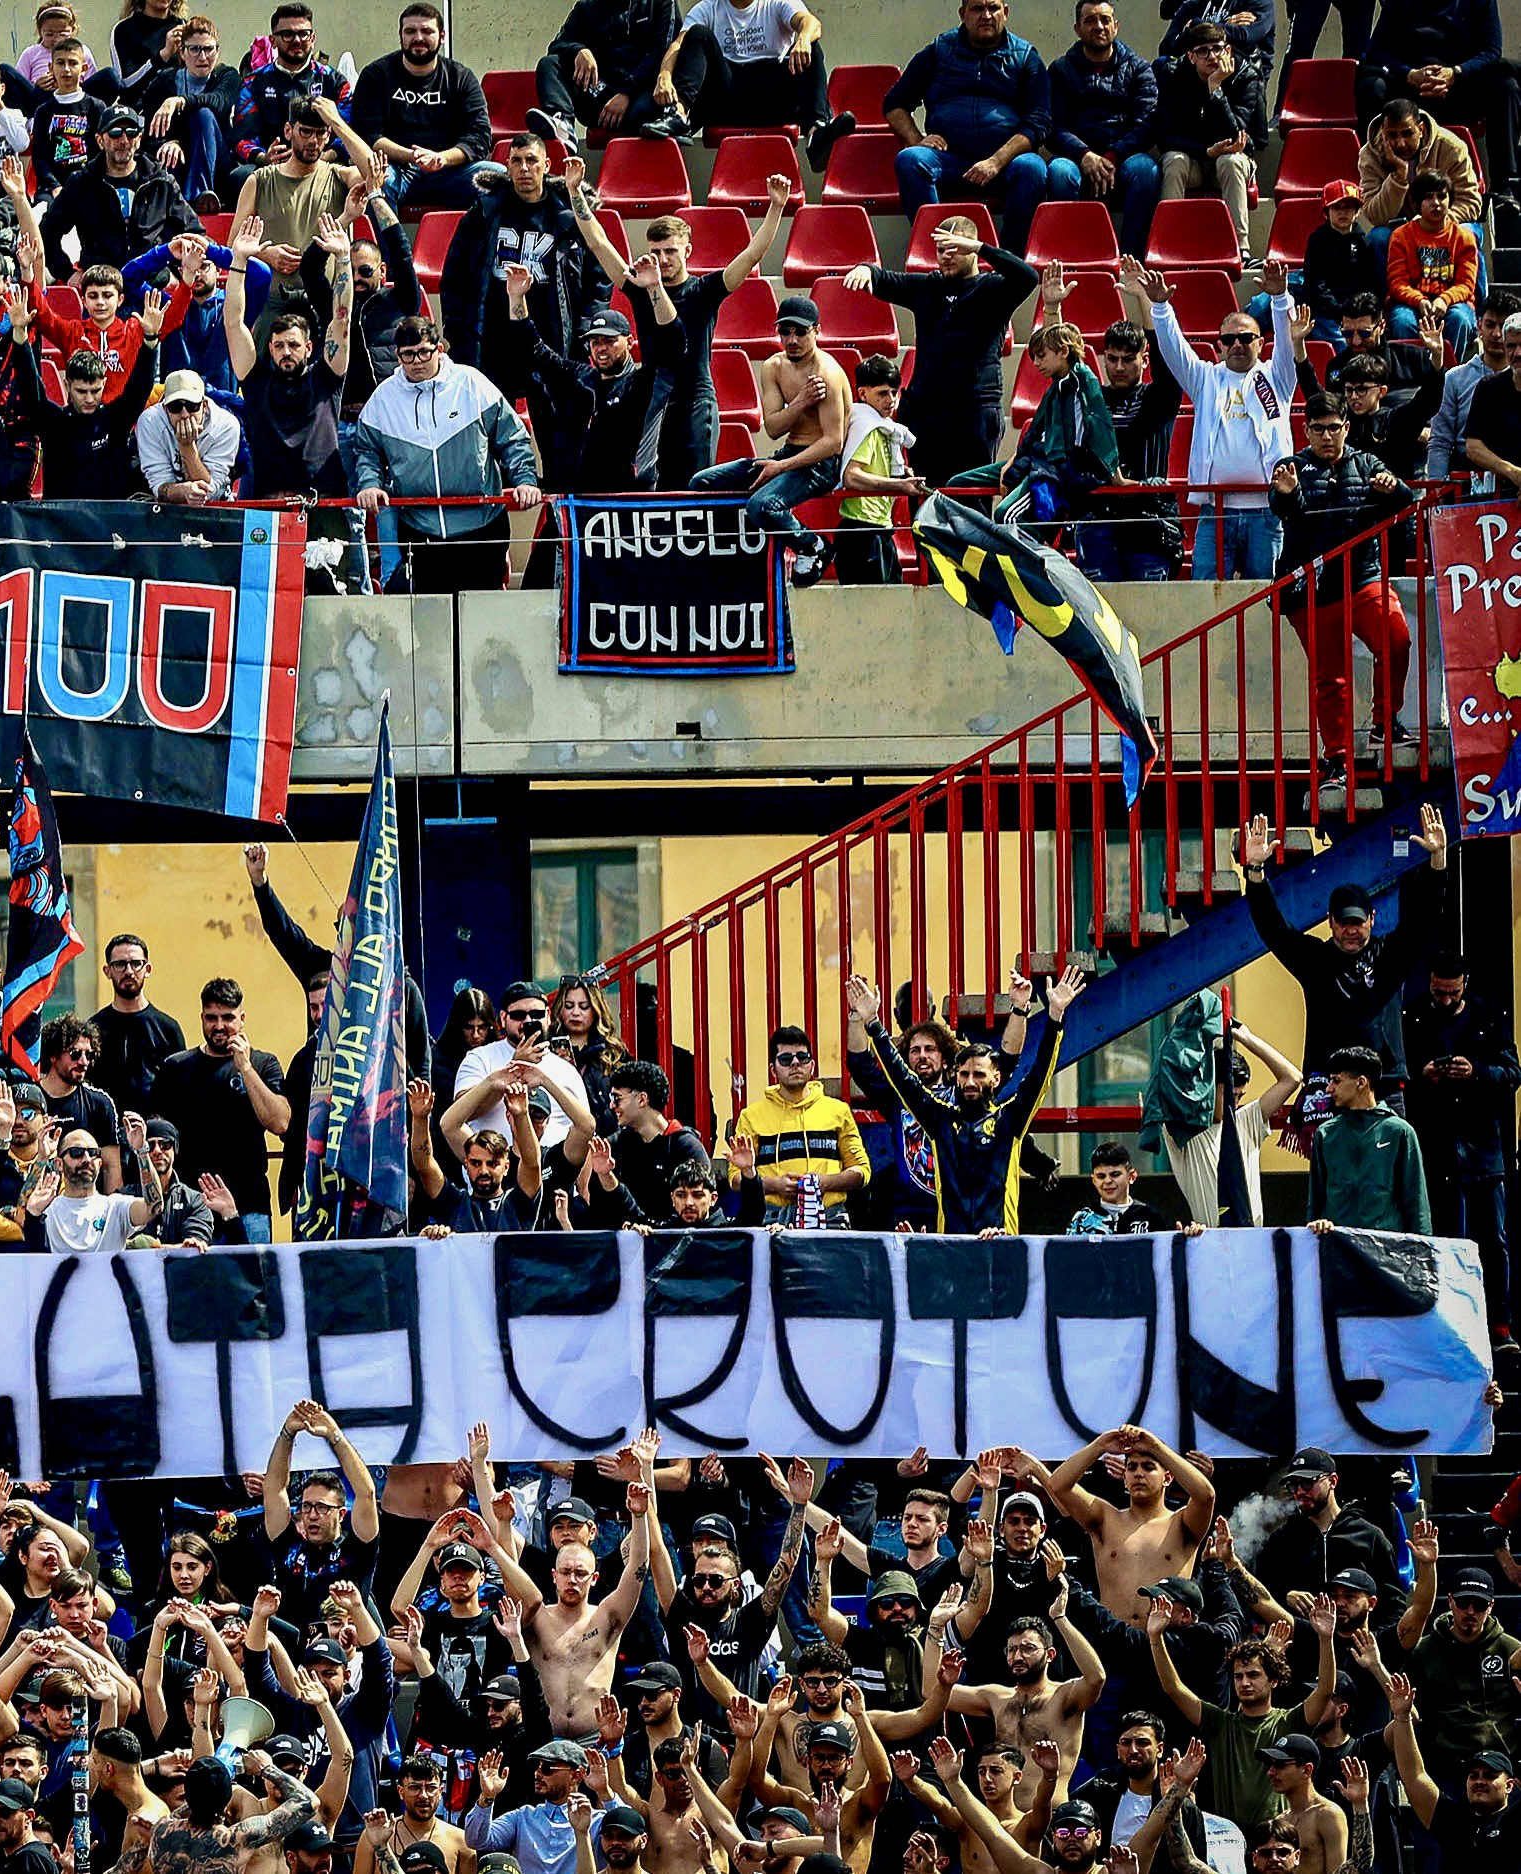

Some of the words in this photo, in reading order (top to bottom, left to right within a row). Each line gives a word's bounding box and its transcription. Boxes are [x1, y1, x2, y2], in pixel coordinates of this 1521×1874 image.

[584, 508, 766, 559] ANGELO
[589, 602, 677, 652] CON
[689, 602, 765, 652] NOI
[496, 1228, 1439, 1460] CROTONE
[709, 1641, 740, 1656] das
